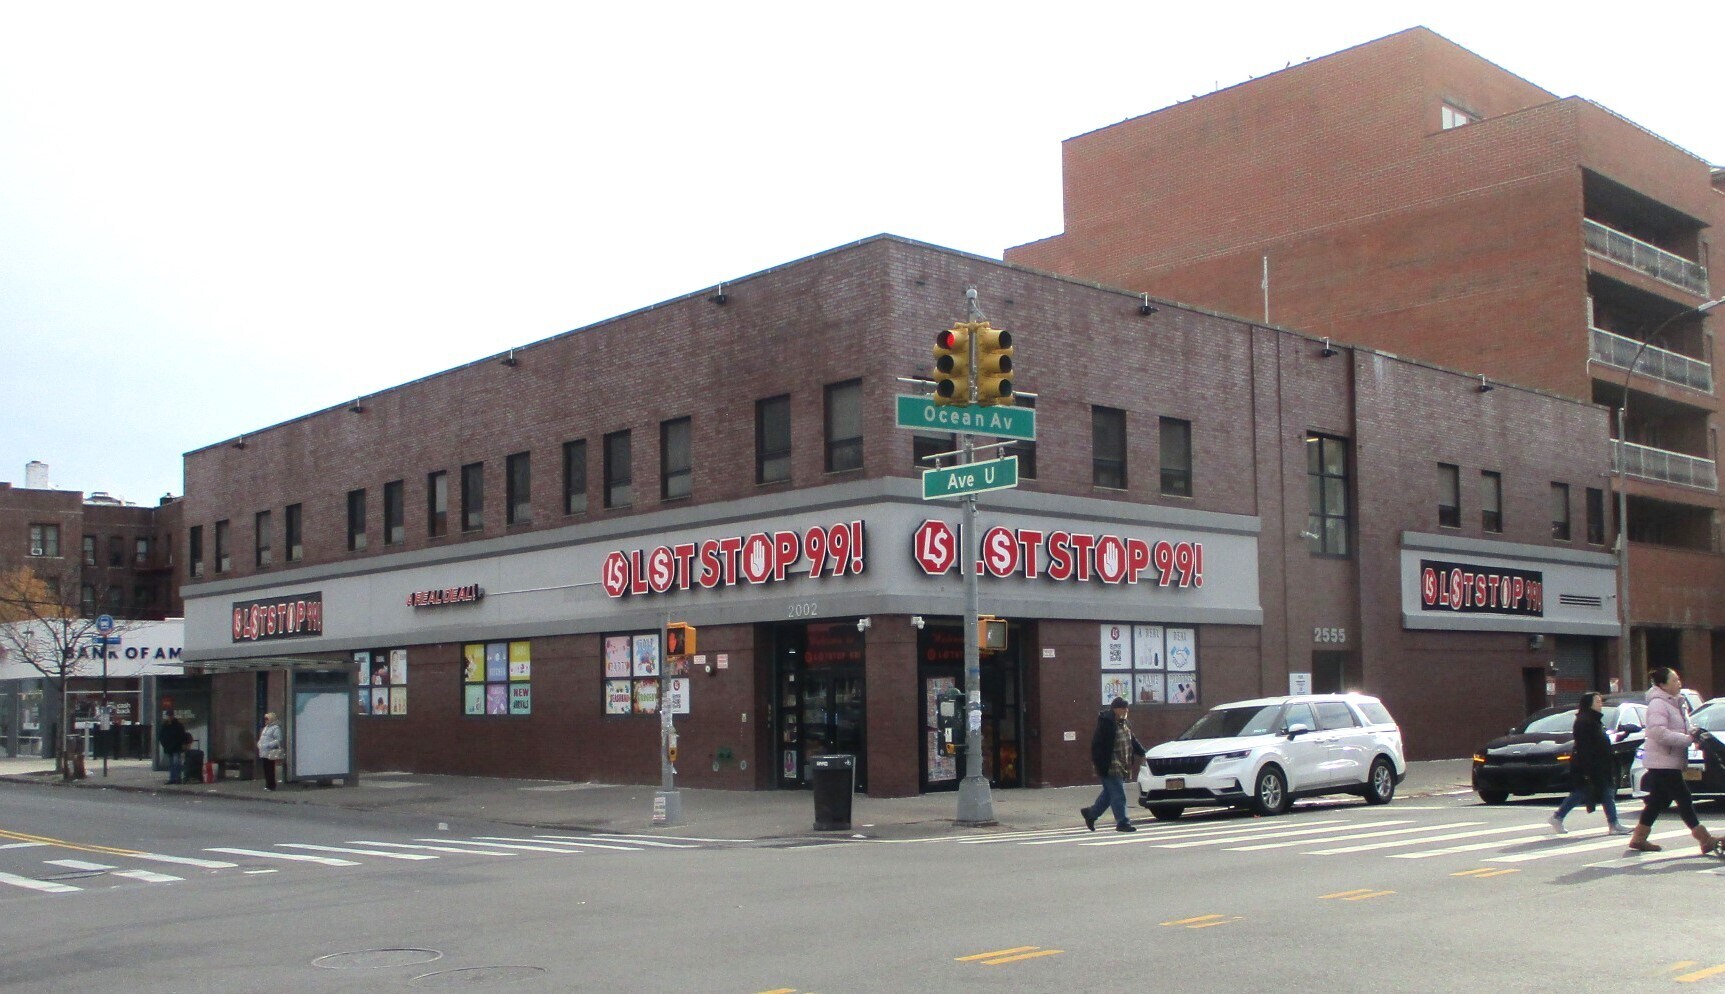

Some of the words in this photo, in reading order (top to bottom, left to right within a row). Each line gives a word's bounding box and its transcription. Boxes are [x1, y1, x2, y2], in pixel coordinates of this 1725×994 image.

[924, 405, 984, 427] Ocean
[990, 412, 1013, 430] Av
[947, 473, 975, 490] Ave
[985, 466, 995, 484] U
[804, 520, 863, 579] 99!
[1155, 540, 1203, 588] 99!
[406, 593, 414, 606] A
[415, 590, 442, 606] REAL
[443, 584, 478, 603] DEAL!
[788, 602, 818, 618] 2002
[1314, 627, 1346, 643] 2555
[125, 647, 149, 659] OF
[513, 688, 529, 697] NEW
